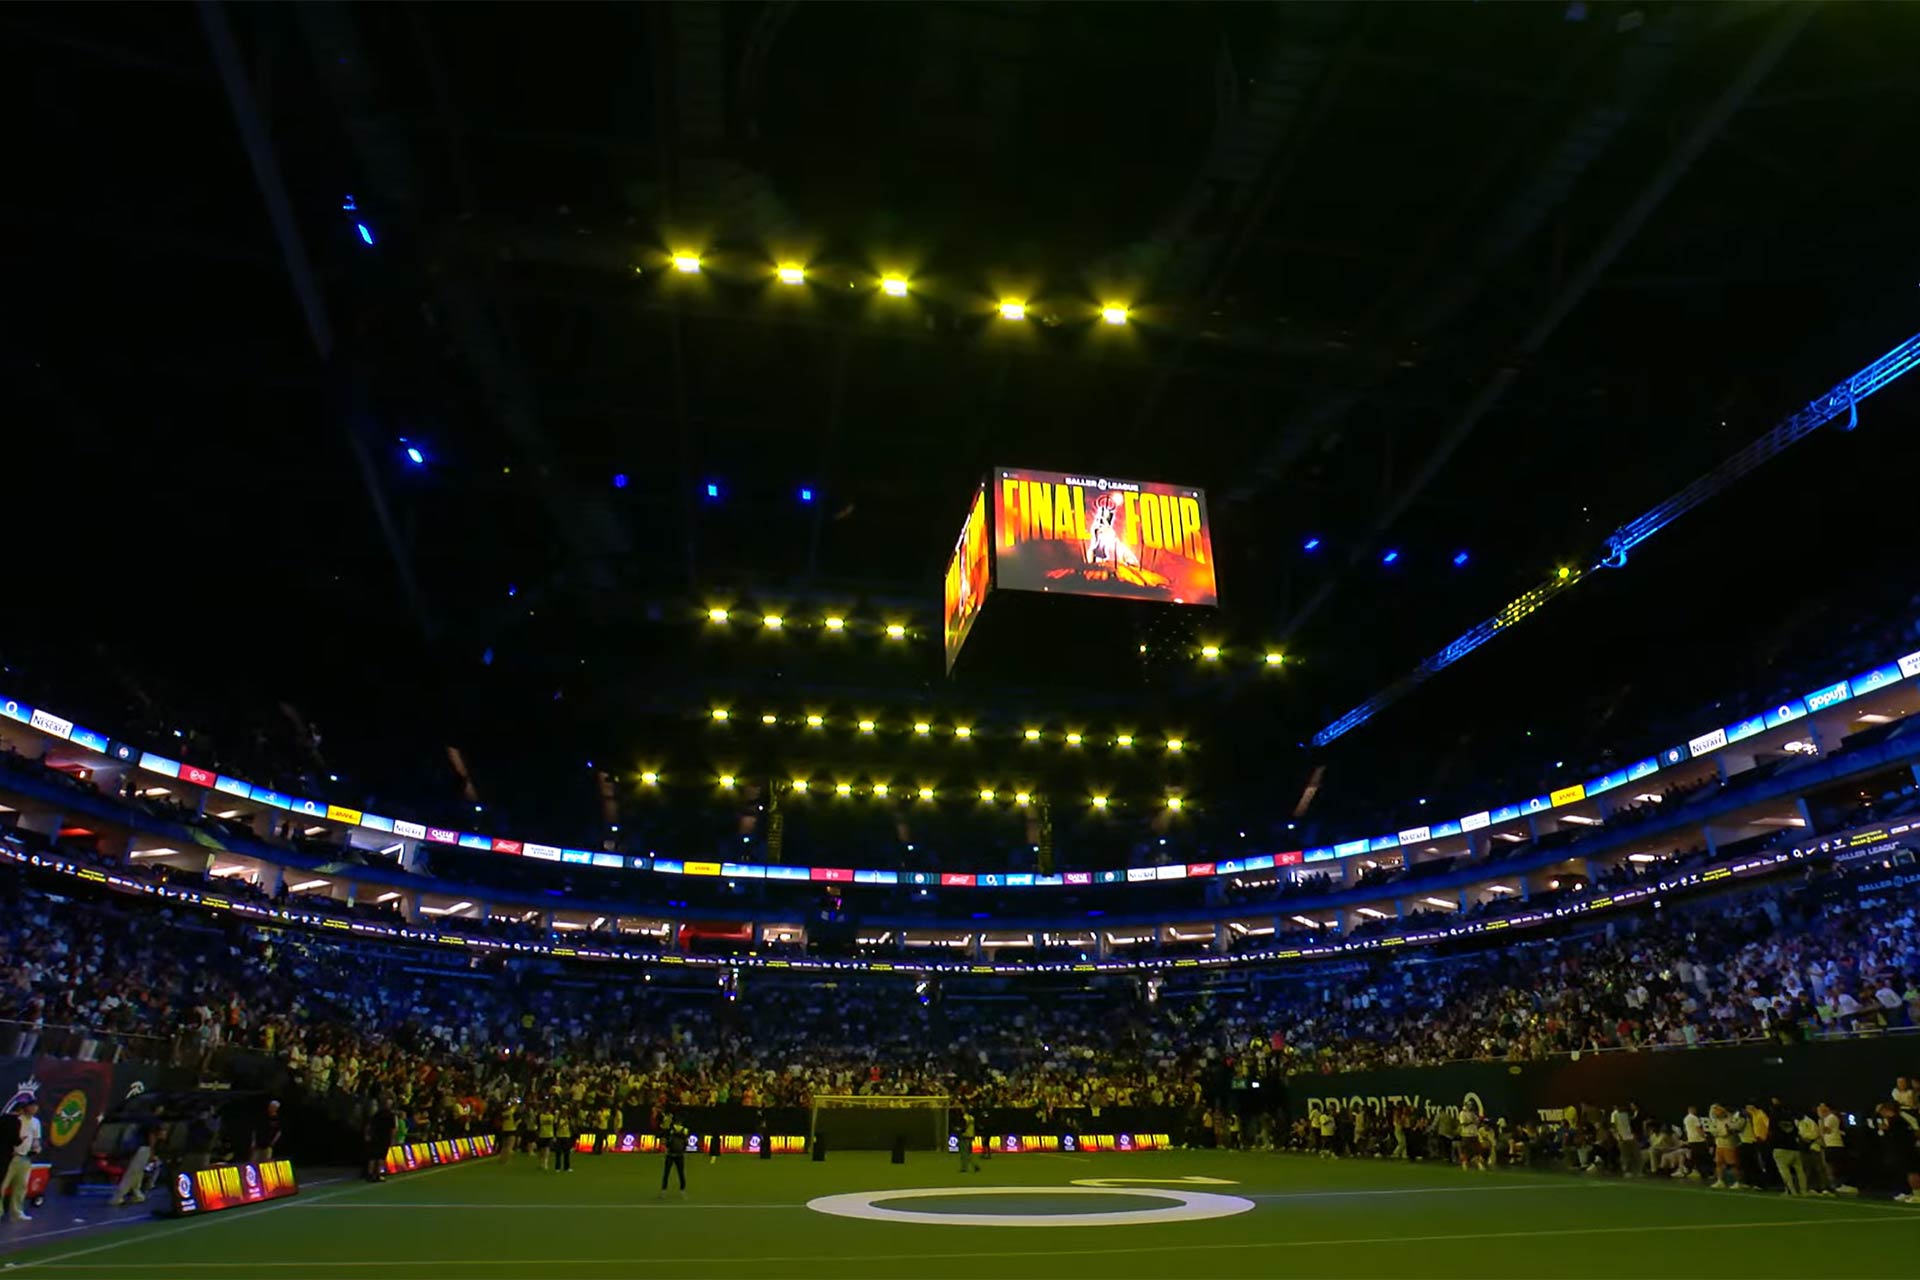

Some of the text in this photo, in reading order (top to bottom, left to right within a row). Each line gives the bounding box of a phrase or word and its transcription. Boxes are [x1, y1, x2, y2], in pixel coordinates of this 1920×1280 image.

[1065, 477, 1139, 491] BALLER LEAGUE
[1001, 478, 1205, 564] FINAL FOUR
[1808, 684, 1848, 711] gopuff
[33, 715, 69, 736] NESCAFÉ
